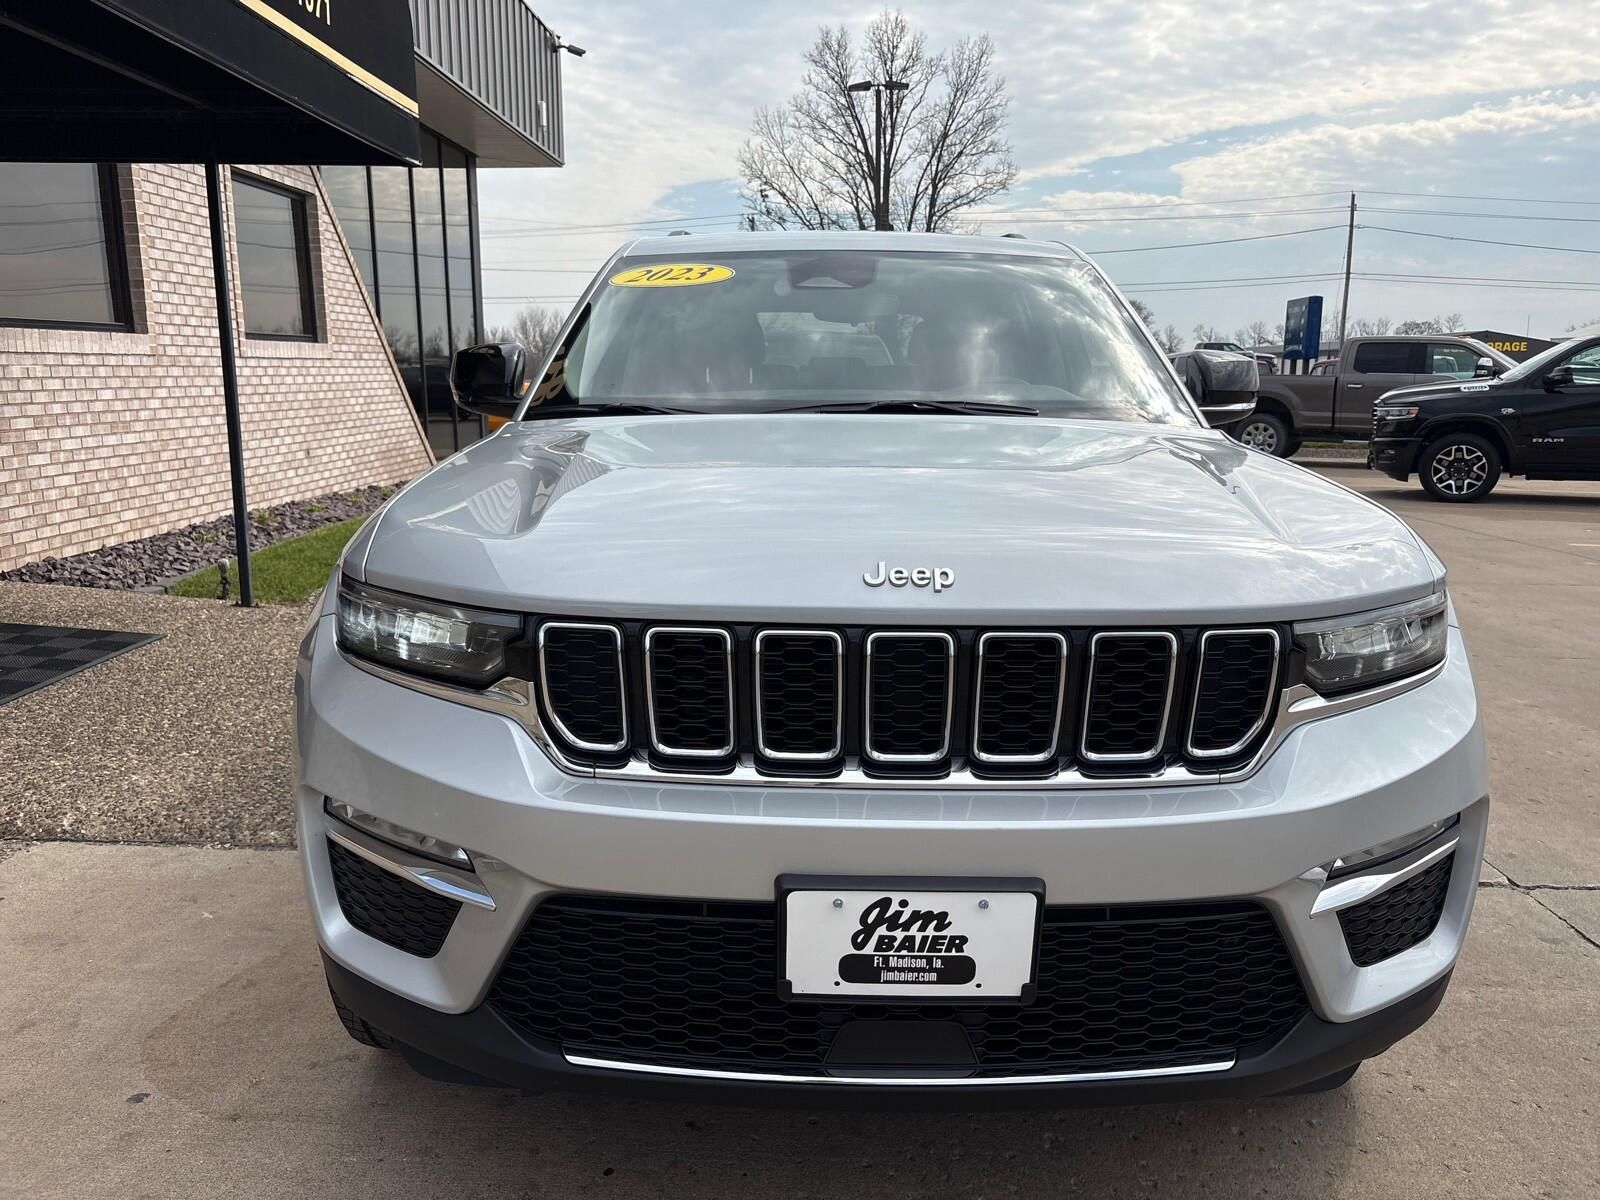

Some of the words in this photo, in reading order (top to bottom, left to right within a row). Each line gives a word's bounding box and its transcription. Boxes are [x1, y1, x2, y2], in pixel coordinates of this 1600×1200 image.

[624, 267, 714, 282] 2023
[863, 561, 955, 593] Jeep
[850, 896, 952, 951] Jim
[873, 934, 969, 953] BAIER
[873, 956, 886, 968] Ft.
[889, 956, 930, 969] Madison,
[880, 970, 937, 983] jimbaier.com
